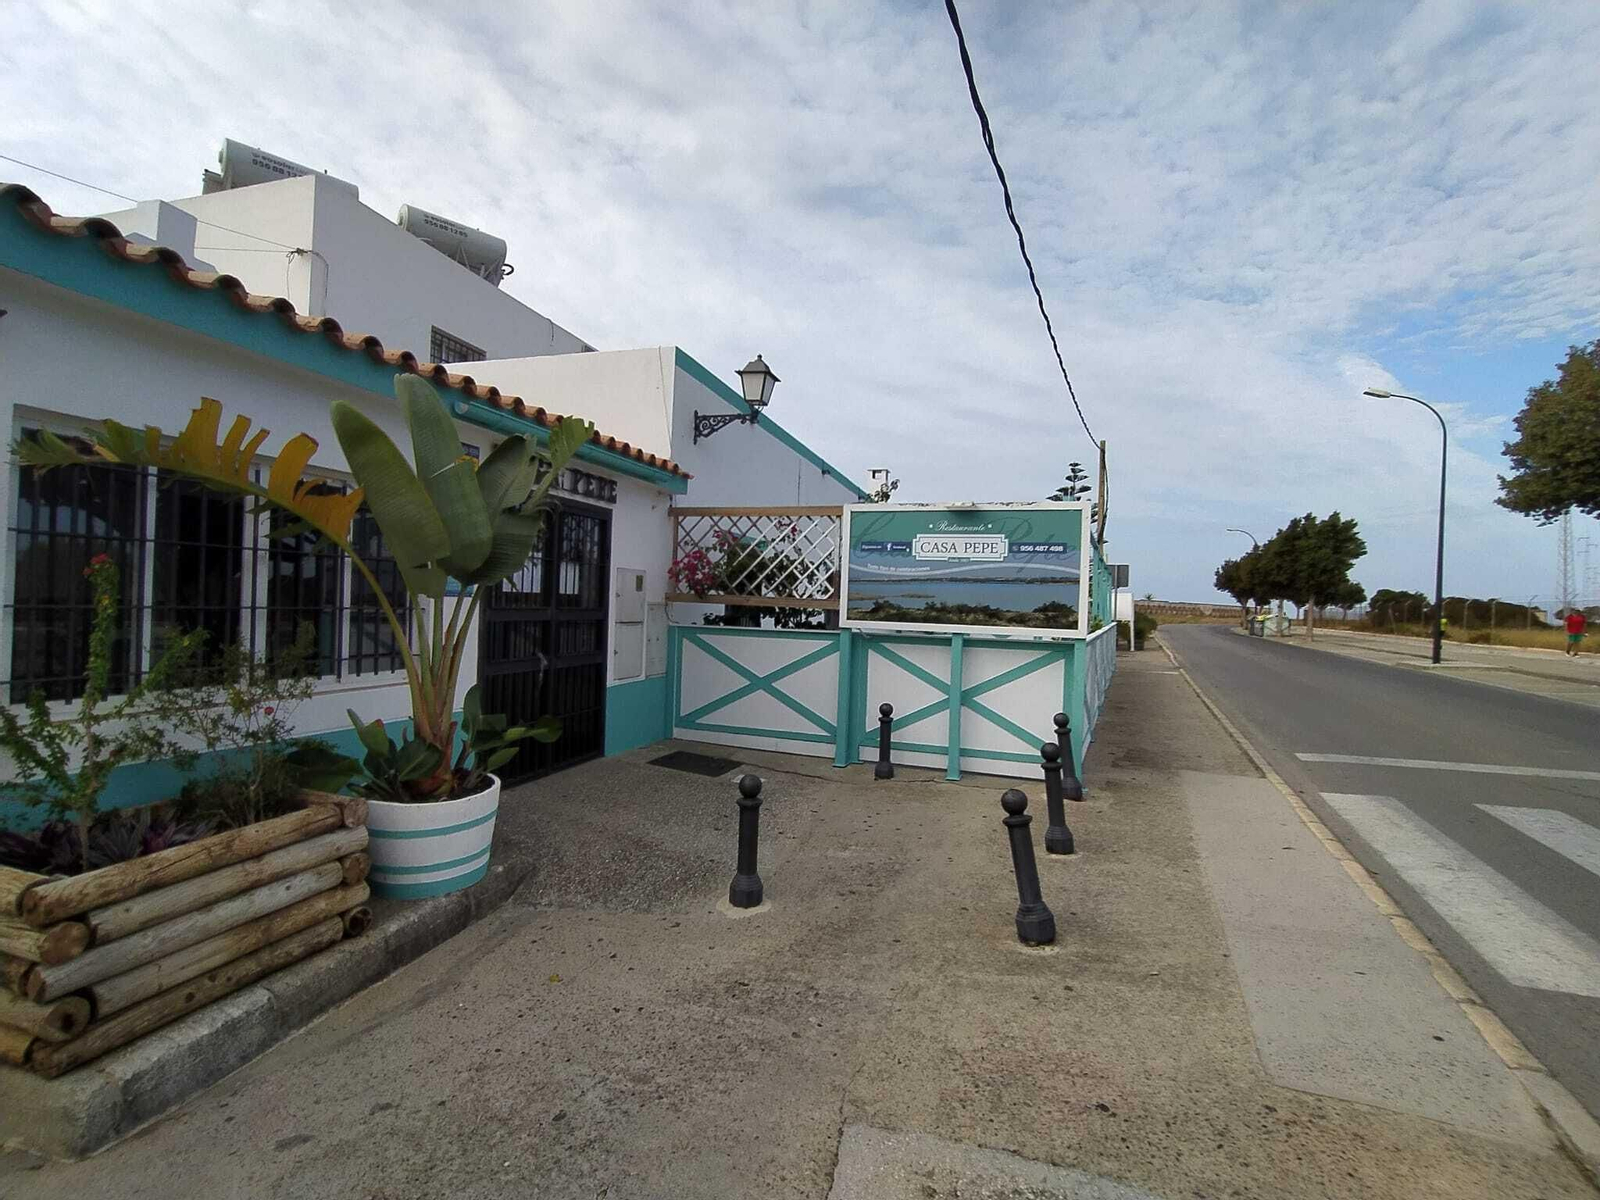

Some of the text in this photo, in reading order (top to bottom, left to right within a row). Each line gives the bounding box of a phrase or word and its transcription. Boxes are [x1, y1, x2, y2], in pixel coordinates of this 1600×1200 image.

[935, 519, 986, 532] Restaurante
[920, 542, 999, 554] CASA PEPE
